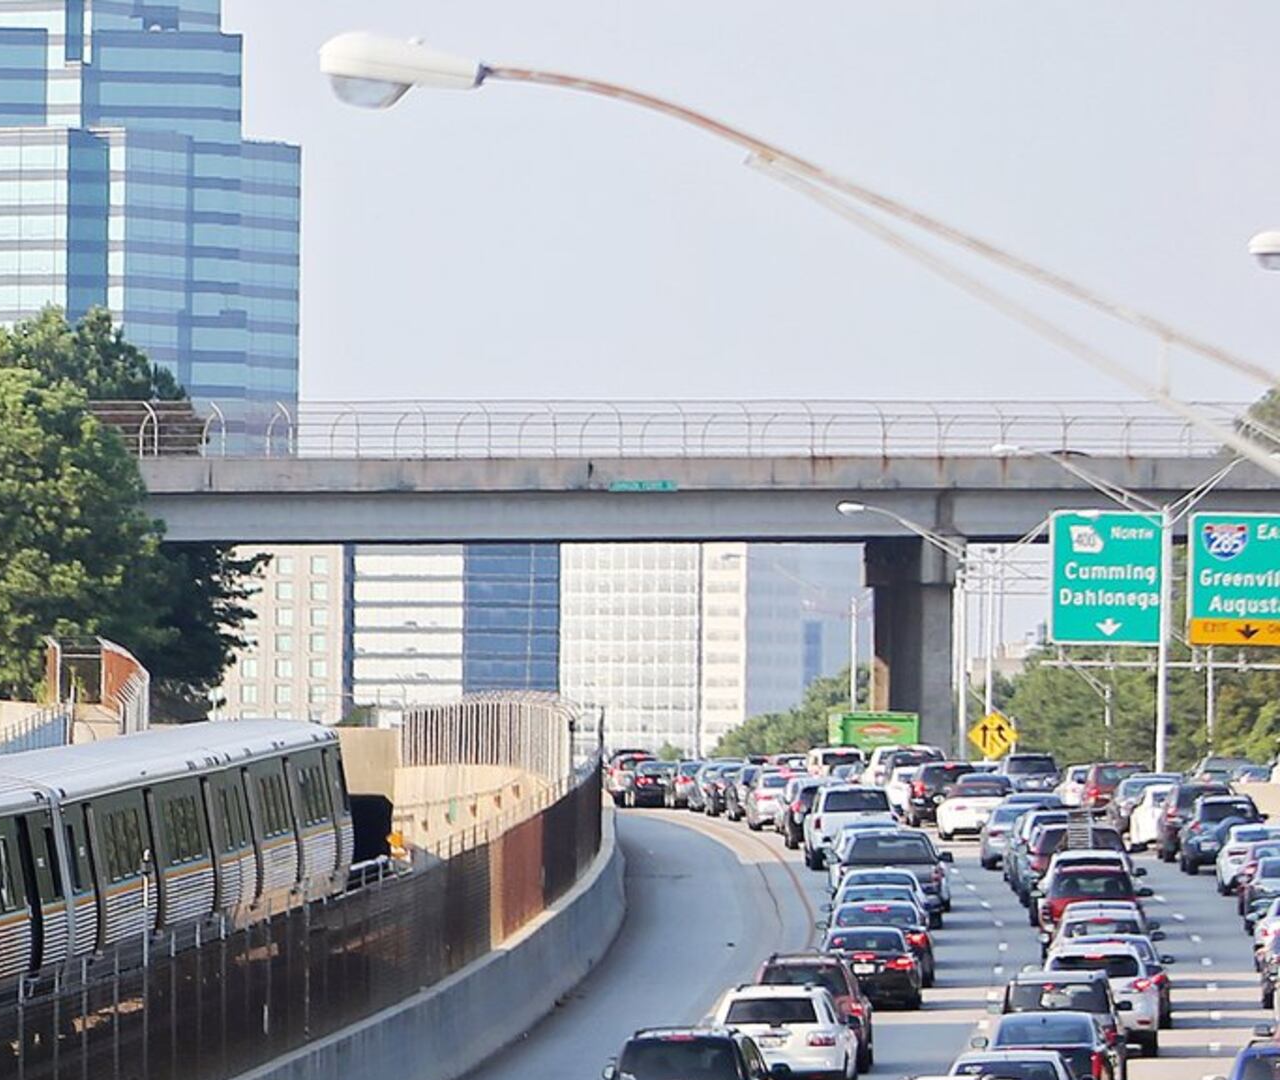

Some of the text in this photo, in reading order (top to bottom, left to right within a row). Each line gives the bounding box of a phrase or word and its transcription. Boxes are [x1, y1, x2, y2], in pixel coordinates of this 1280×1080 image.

[1064, 561, 1156, 586] Cumming
[1059, 587, 1159, 611] Dahlonega
[1208, 594, 1280, 617] August
